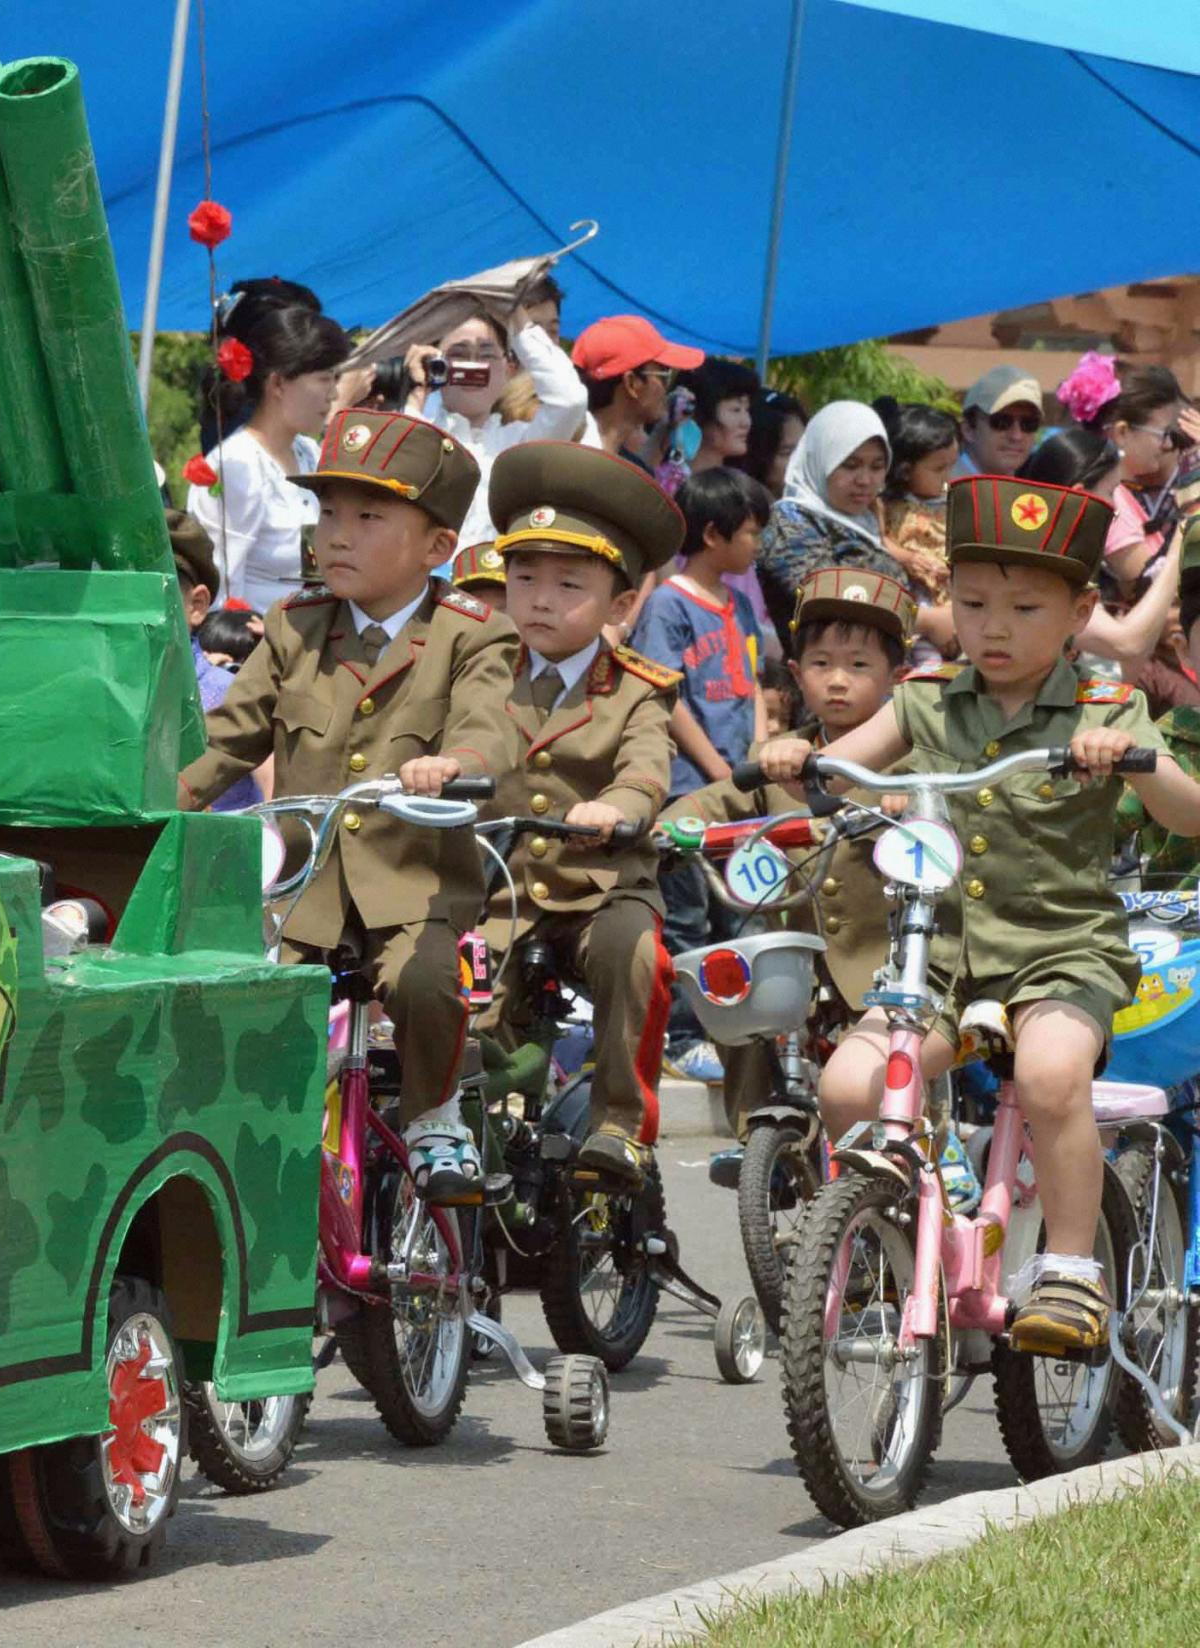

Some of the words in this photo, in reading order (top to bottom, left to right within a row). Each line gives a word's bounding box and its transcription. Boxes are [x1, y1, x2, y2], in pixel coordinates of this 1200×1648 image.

[737, 854, 779, 893] 10
[905, 840, 924, 879] 1
[1132, 941, 1156, 965] 5
